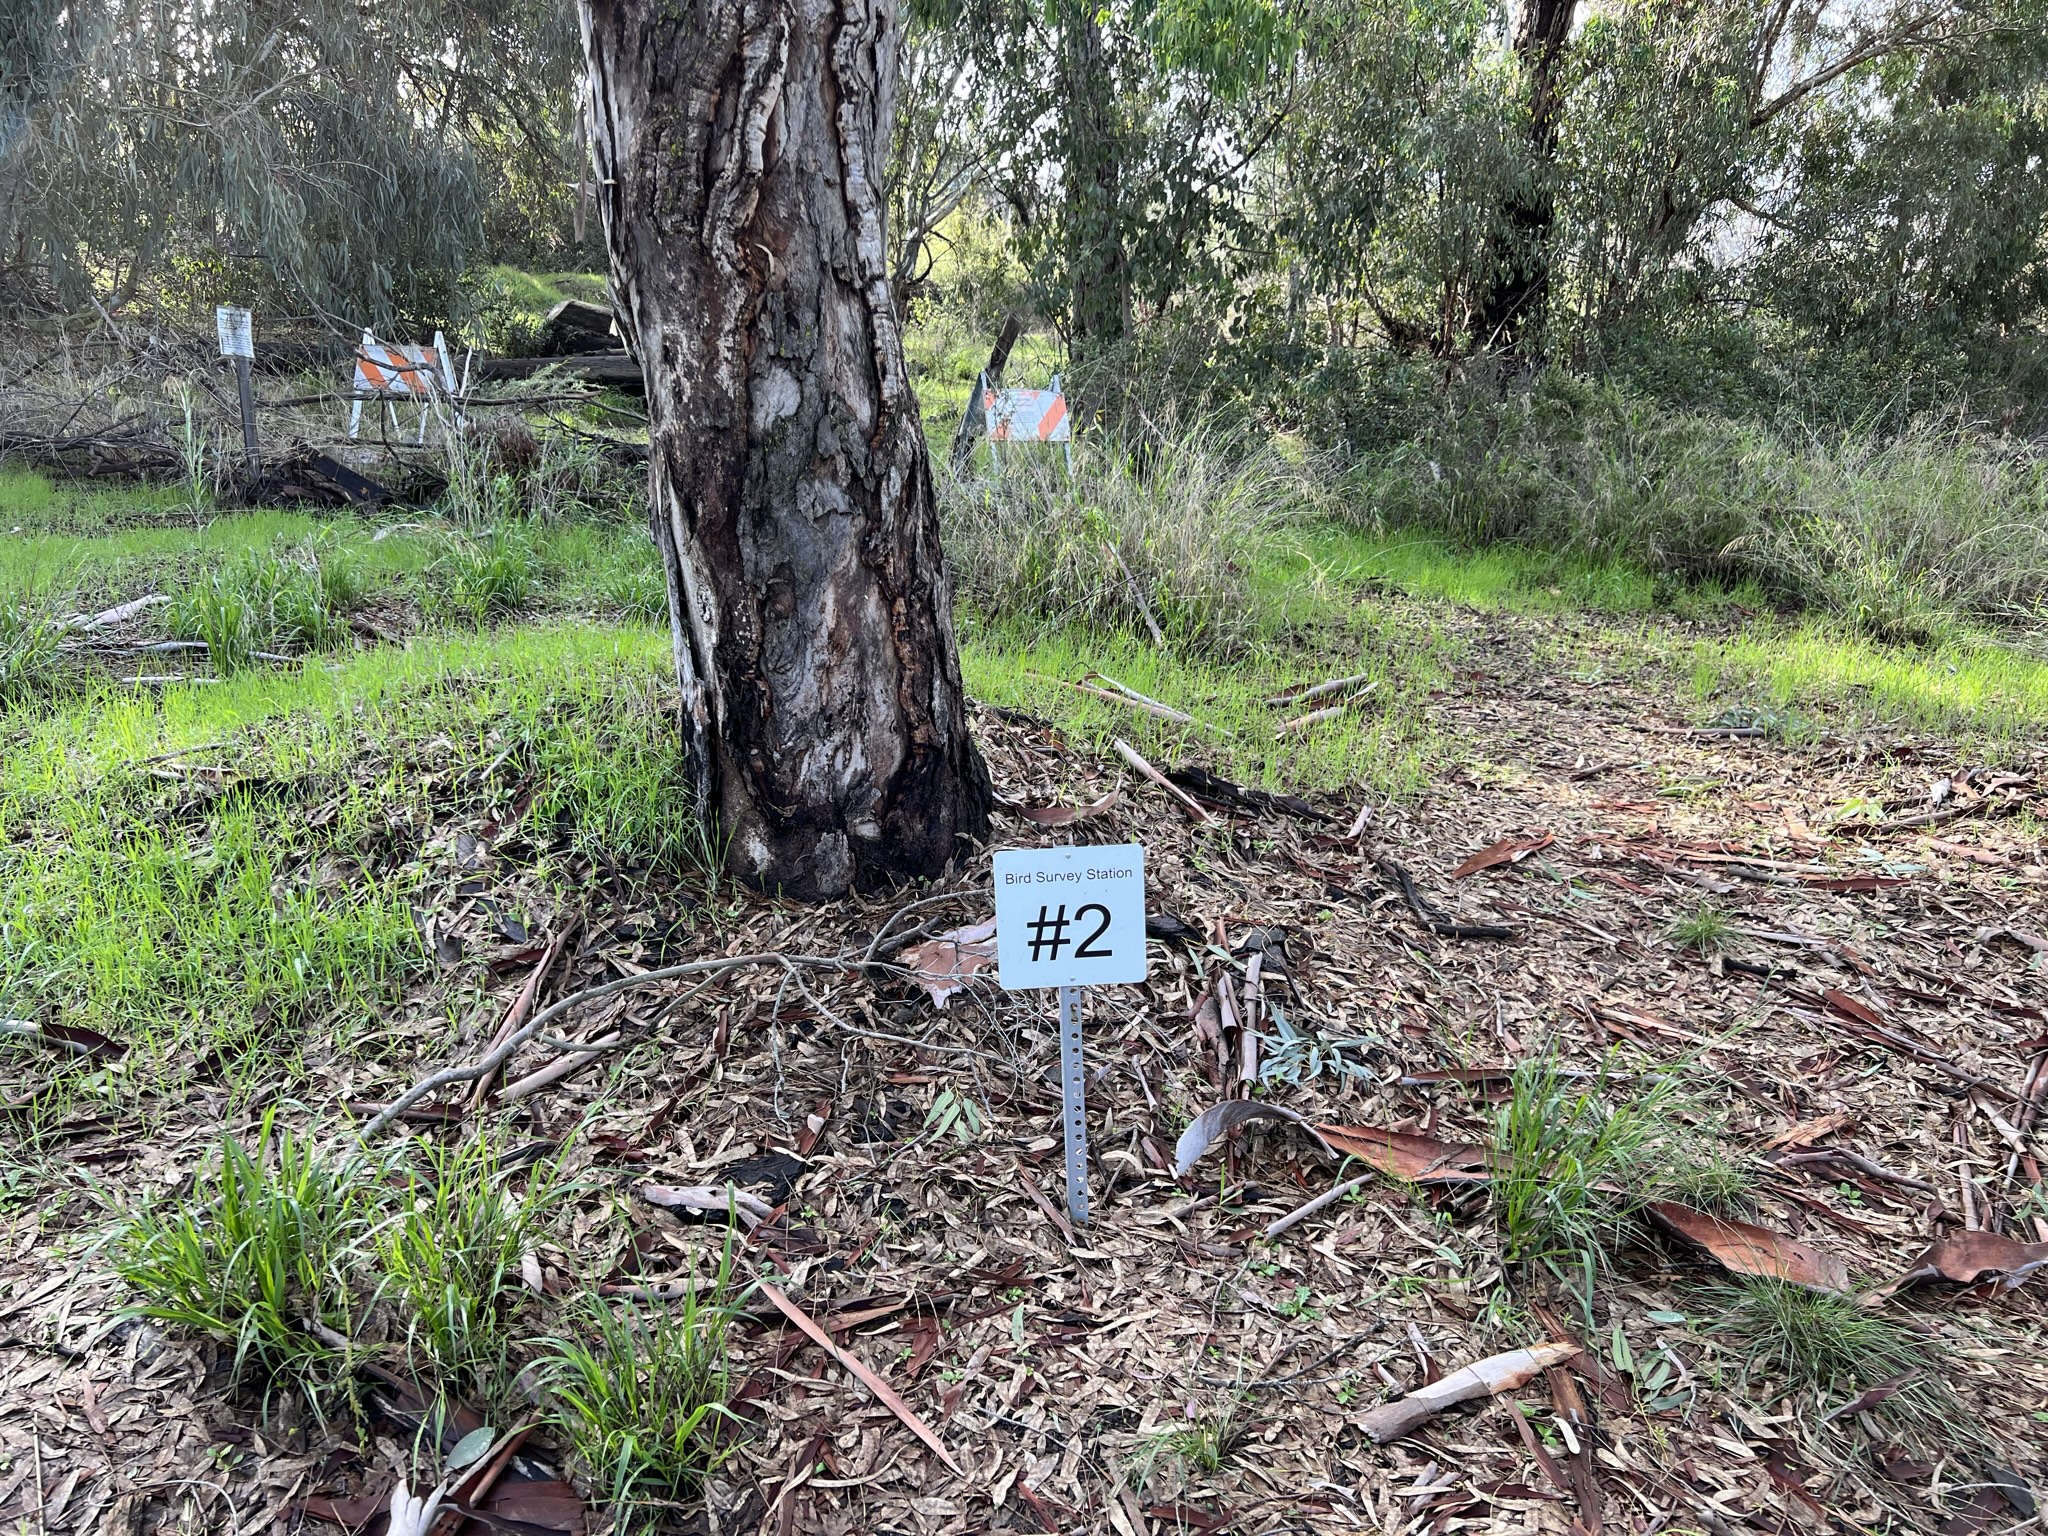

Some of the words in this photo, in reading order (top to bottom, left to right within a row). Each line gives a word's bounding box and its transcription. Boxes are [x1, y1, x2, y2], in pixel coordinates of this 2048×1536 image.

[1005, 873, 1031, 885] Bird
[1036, 871, 1082, 884] Survey
[1086, 868, 1133, 880] Station
[1026, 903, 1113, 962] #2
